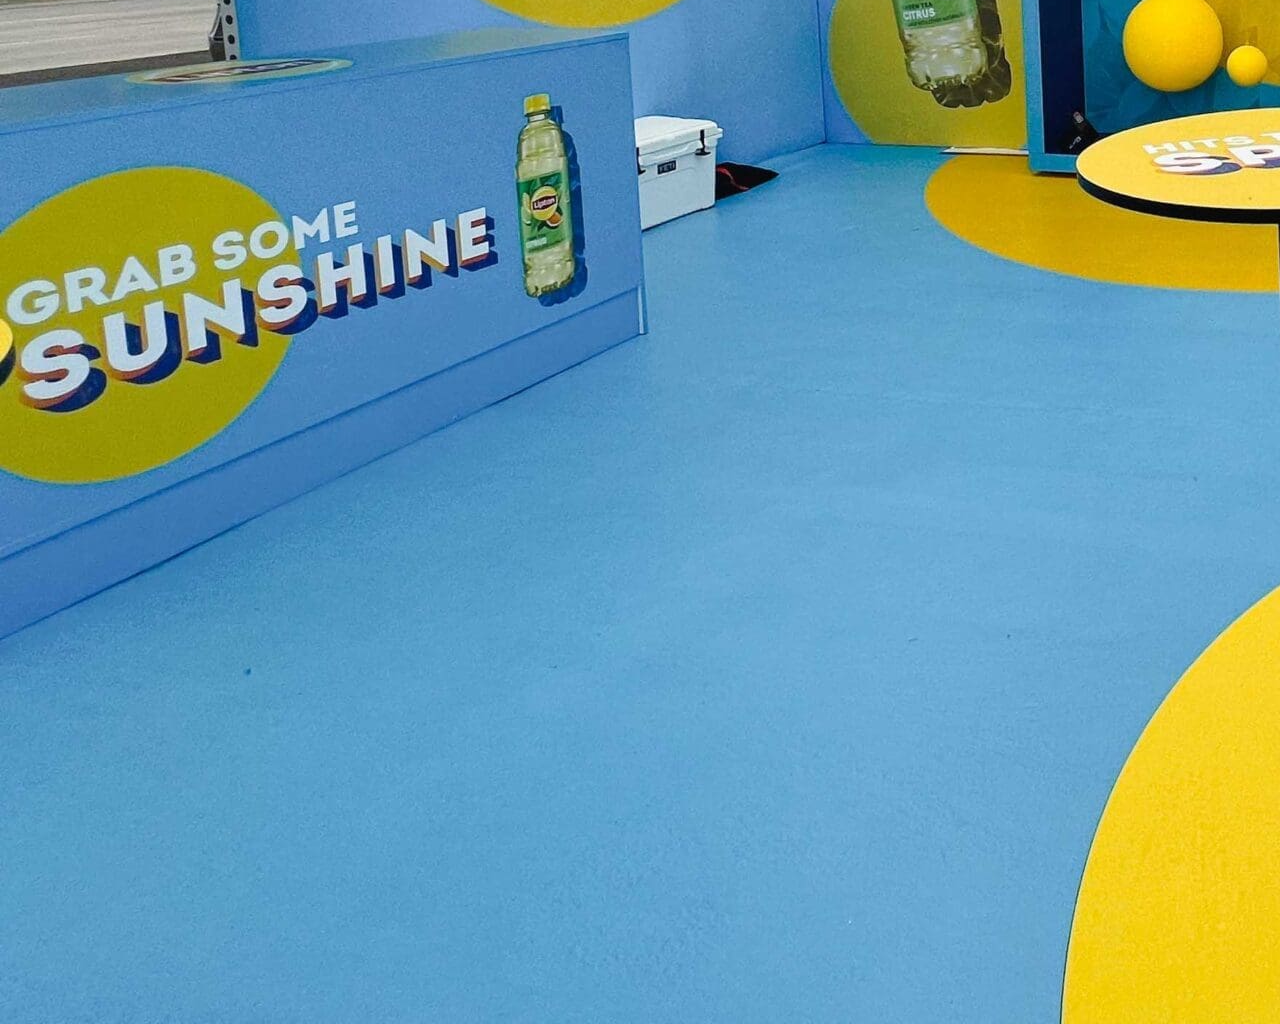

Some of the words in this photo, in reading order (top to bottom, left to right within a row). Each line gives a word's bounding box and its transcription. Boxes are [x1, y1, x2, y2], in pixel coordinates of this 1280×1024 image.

[902, 7, 937, 21] CITRUS
[1141, 134, 1255, 153] HITS
[6, 243, 197, 325] GRAB
[211, 200, 359, 271] SOME
[19, 206, 499, 413] SUNSHINE
